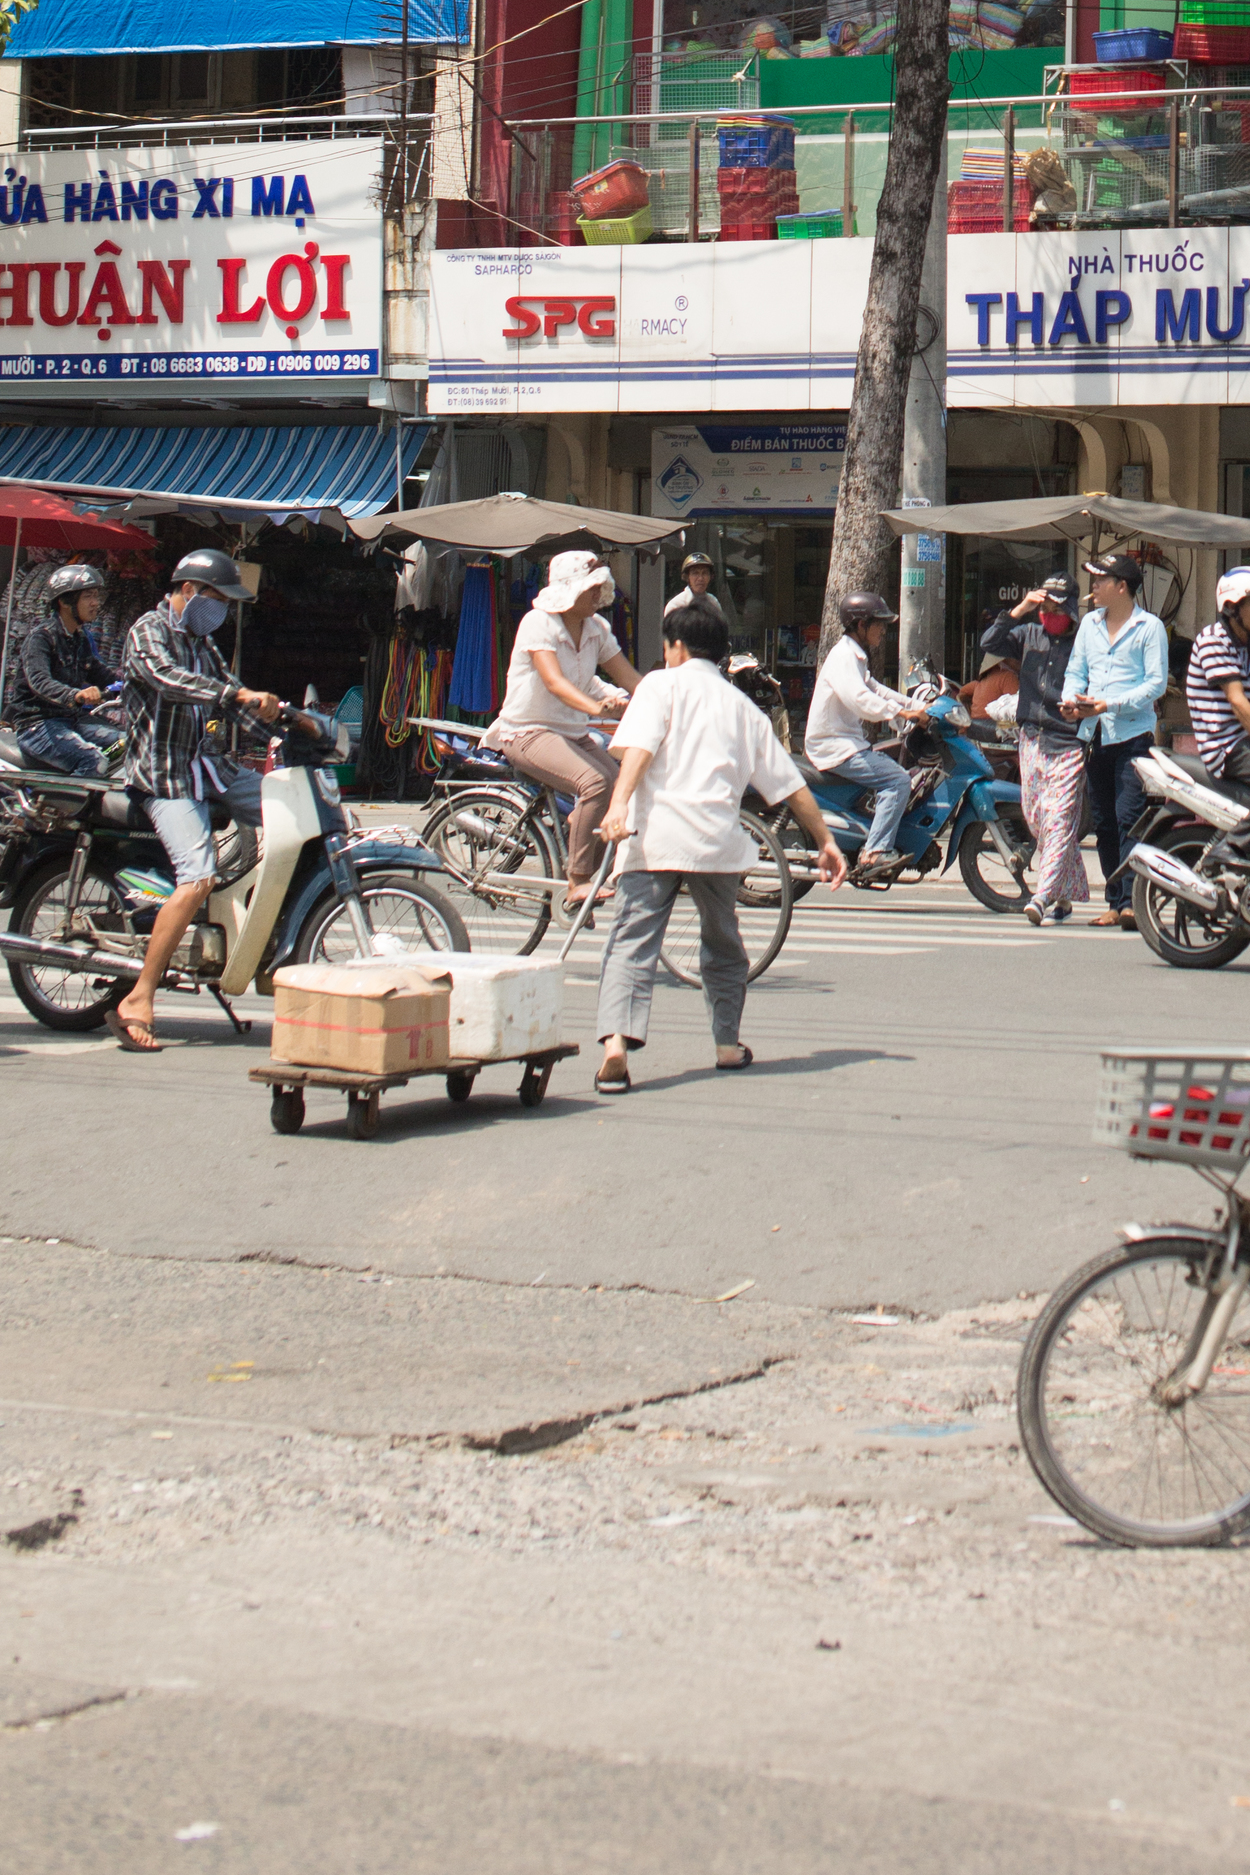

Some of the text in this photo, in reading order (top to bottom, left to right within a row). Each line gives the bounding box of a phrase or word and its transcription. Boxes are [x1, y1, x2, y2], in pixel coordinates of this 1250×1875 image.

[64, 170, 179, 223] HÀNG
[192, 177, 235, 218] XI
[251, 174, 316, 228] MẠ
[446, 253, 466, 262] CÔNG
[1068, 237, 1205, 275] NHÀ THUỐC
[474, 264, 533, 275] SAPHARCO
[216, 241, 351, 340] LỢI
[502, 295, 616, 338] SPG
[964, 277, 1132, 347] THÁP
[1, 357, 35, 375] MƯỜI
[151, 358, 167, 373] 08
[171, 357, 203, 373] 6683
[206, 356, 239, 372] 0638
[278, 355, 312, 372] 0906
[314, 354, 340, 371] 009
[343, 354, 370, 370] 296
[834, 425, 849, 436] VIỆ
[731, 435, 762, 451] ĐIỂM
[764, 436, 790, 450] BÁN
[791, 435, 834, 450] THUỐC
[998, 582, 1019, 600] GIỜ
